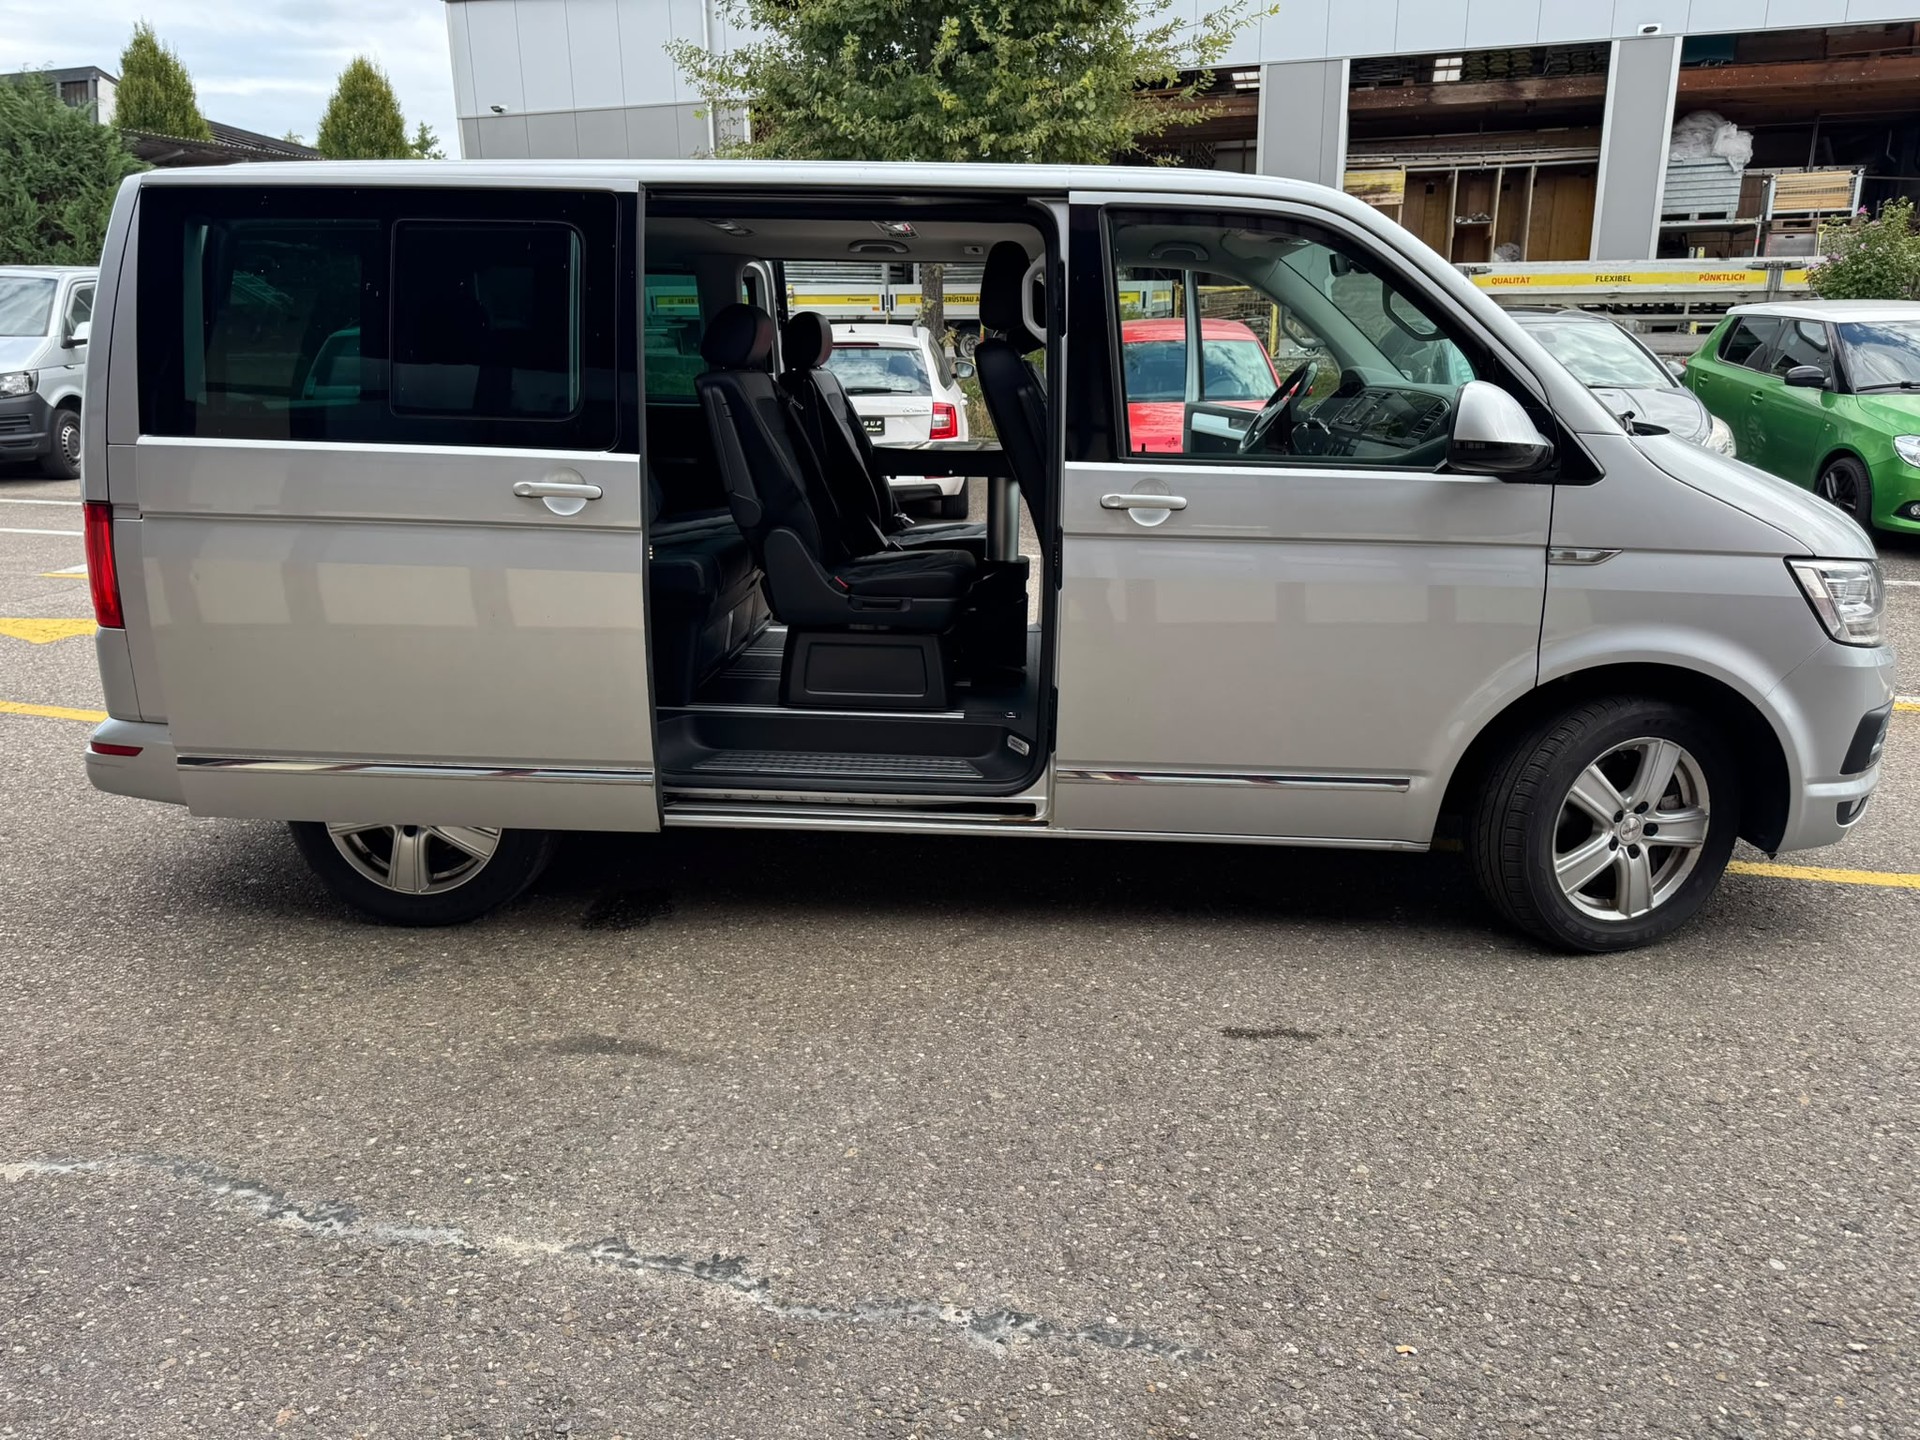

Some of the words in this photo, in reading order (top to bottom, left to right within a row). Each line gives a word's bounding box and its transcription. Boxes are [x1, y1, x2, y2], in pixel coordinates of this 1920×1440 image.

[1491, 275, 1531, 285] QUALITÄT
[1595, 274, 1632, 282] FLEXIBEL
[1698, 272, 1746, 281] PÜNKTLICH
[944, 295, 974, 303] ERÜSTBAU
